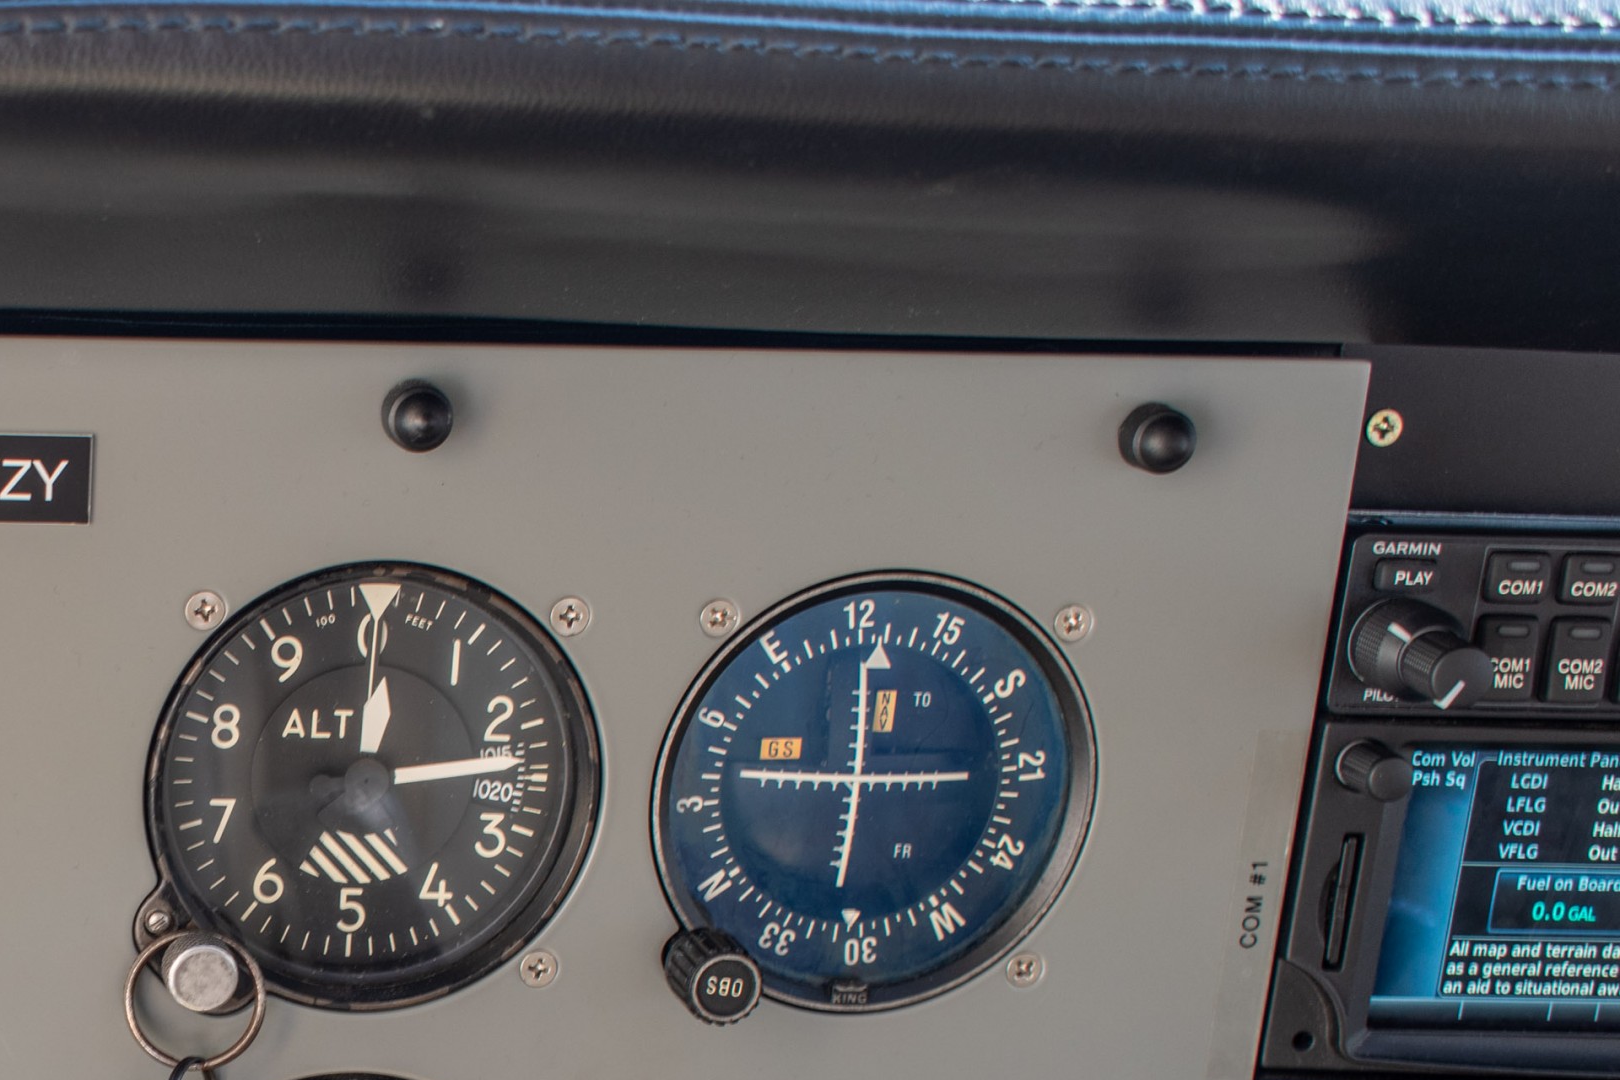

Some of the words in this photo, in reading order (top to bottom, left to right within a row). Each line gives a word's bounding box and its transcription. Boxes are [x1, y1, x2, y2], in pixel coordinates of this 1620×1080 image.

[1373, 541, 1441, 556] GARMIN
[1394, 571, 1433, 586] PLAY
[1498, 580, 1544, 595] COM1
[1571, 581, 1618, 597] COM2
[404, 613, 434, 631] FEET
[843, 599, 875, 630] 12
[932, 612, 965, 645] 15
[271, 635, 303, 683] 9
[450, 638, 461, 686] 1
[1558, 658, 1604, 674] COM2
[1494, 673, 1524, 689] MIC
[1564, 675, 1595, 690] MIC
[914, 691, 931, 708] TO
[210, 703, 240, 749] 8
[281, 709, 354, 739] ALT
[483, 695, 514, 743] 2
[1412, 750, 1446, 767] Com
[1451, 751, 1476, 767] Vol
[1497, 750, 1586, 768] Instrument
[1411, 770, 1440, 786] Psh
[1445, 770, 1466, 790] Sq
[472, 779, 513, 802] 1020
[1506, 797, 1546, 813] LFLG
[209, 798, 237, 844] 7
[474, 812, 506, 858] 3
[893, 843, 912, 858] FR
[1498, 843, 1538, 859] VFLG
[252, 857, 284, 904] 6
[1250, 861, 1269, 885] #1
[1517, 874, 1551, 891] Fuel
[418, 862, 453, 907] 4
[336, 888, 366, 933] 5
[1531, 901, 1566, 922] 0.0
[1568, 906, 1596, 922] GAL
[1239, 895, 1263, 949] COM
[1472, 944, 1508, 960] map
[1511, 943, 1542, 958] and
[1545, 943, 1597, 958] terrain
[1482, 961, 1542, 979] general
[1544, 961, 1619, 978] reference
[706, 975, 744, 998] OBS
[1514, 979, 1595, 995] situational
